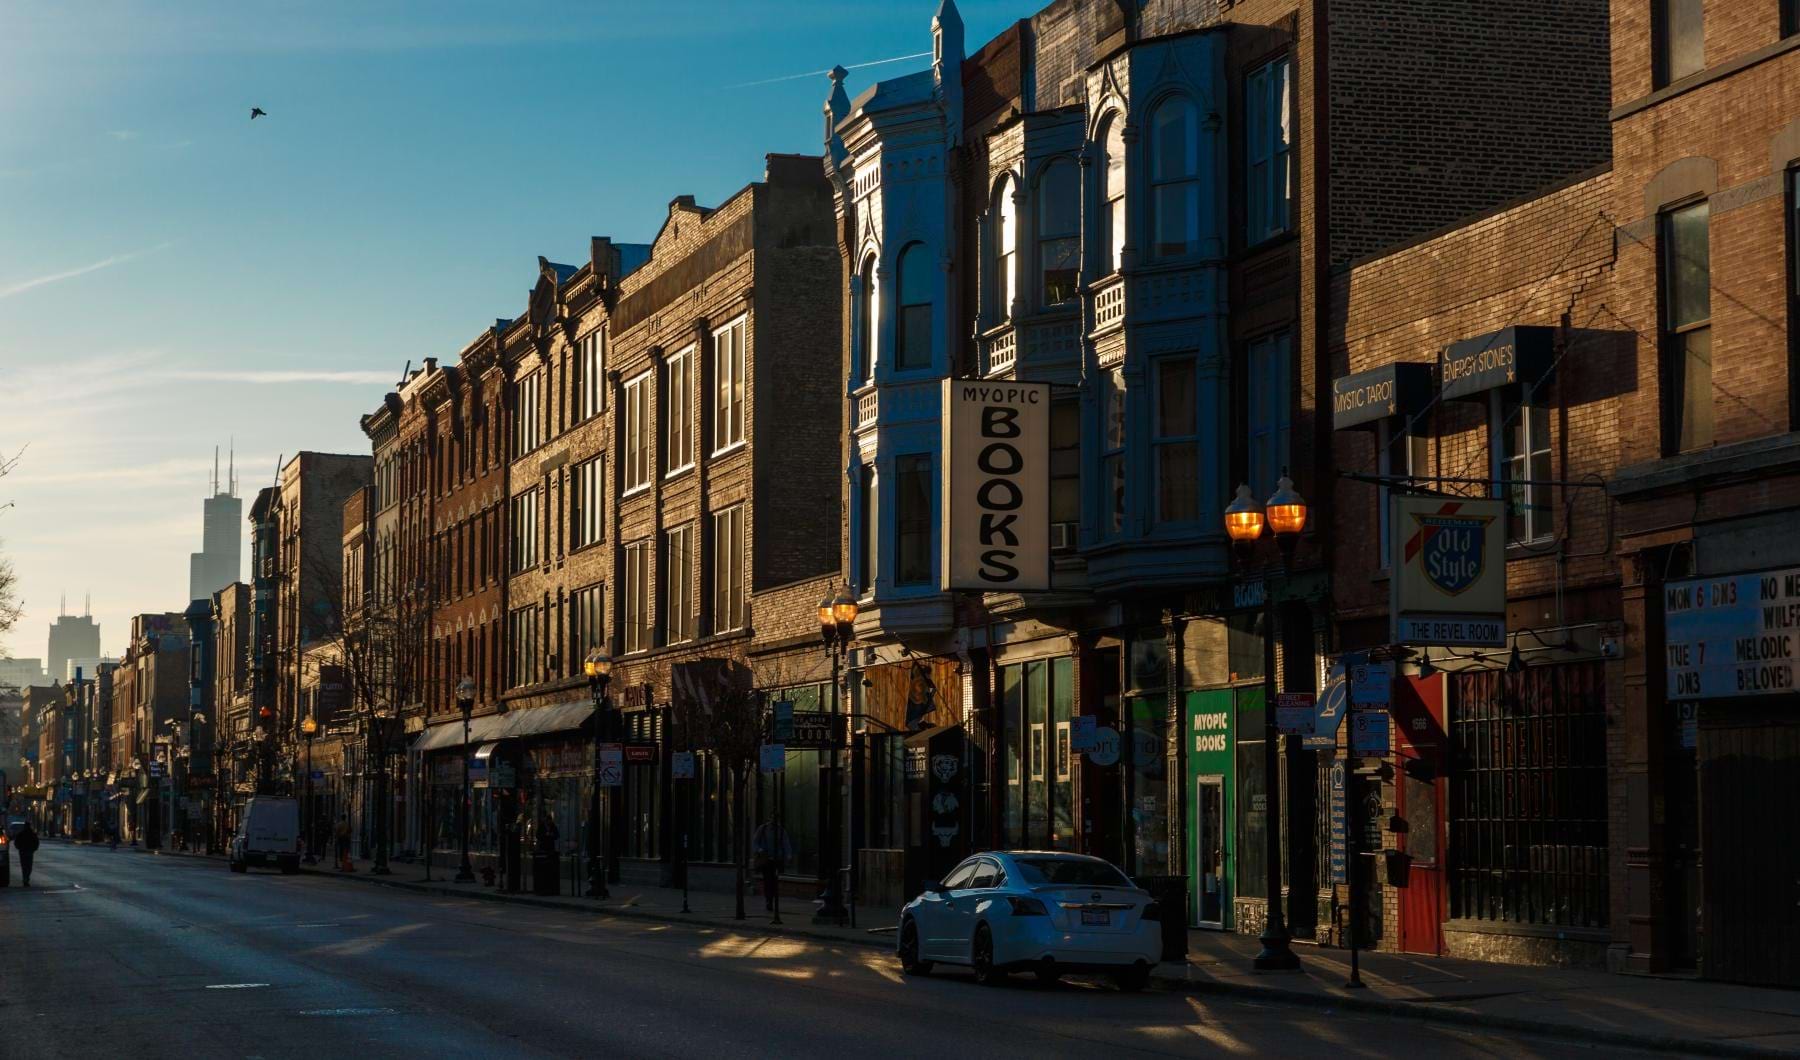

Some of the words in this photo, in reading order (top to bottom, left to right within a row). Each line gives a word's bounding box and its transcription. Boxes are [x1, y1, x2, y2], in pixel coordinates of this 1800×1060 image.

[1443, 358, 1477, 384] ENERGY
[1478, 343, 1513, 375] STONE'S
[963, 387, 1039, 404] MYOPIC
[1334, 388, 1364, 414] MYSTIC
[1366, 380, 1393, 405] TAROT
[977, 406, 1024, 583] BOOKS
[1438, 528, 1471, 553] Old
[1428, 549, 1477, 587] Style
[1667, 588, 1690, 610] MON
[1696, 587, 1704, 607] 6
[1760, 577, 1777, 600] NO
[1410, 622, 1430, 639] THE
[1433, 623, 1465, 640] REVEL
[1468, 624, 1499, 641] ROOM
[1668, 644, 1689, 666] TUE
[1698, 641, 1705, 665] 7
[1736, 635, 1791, 661] MELODIC
[1193, 712, 1228, 731] MYOPIC
[1195, 734, 1227, 752] BOOKS
